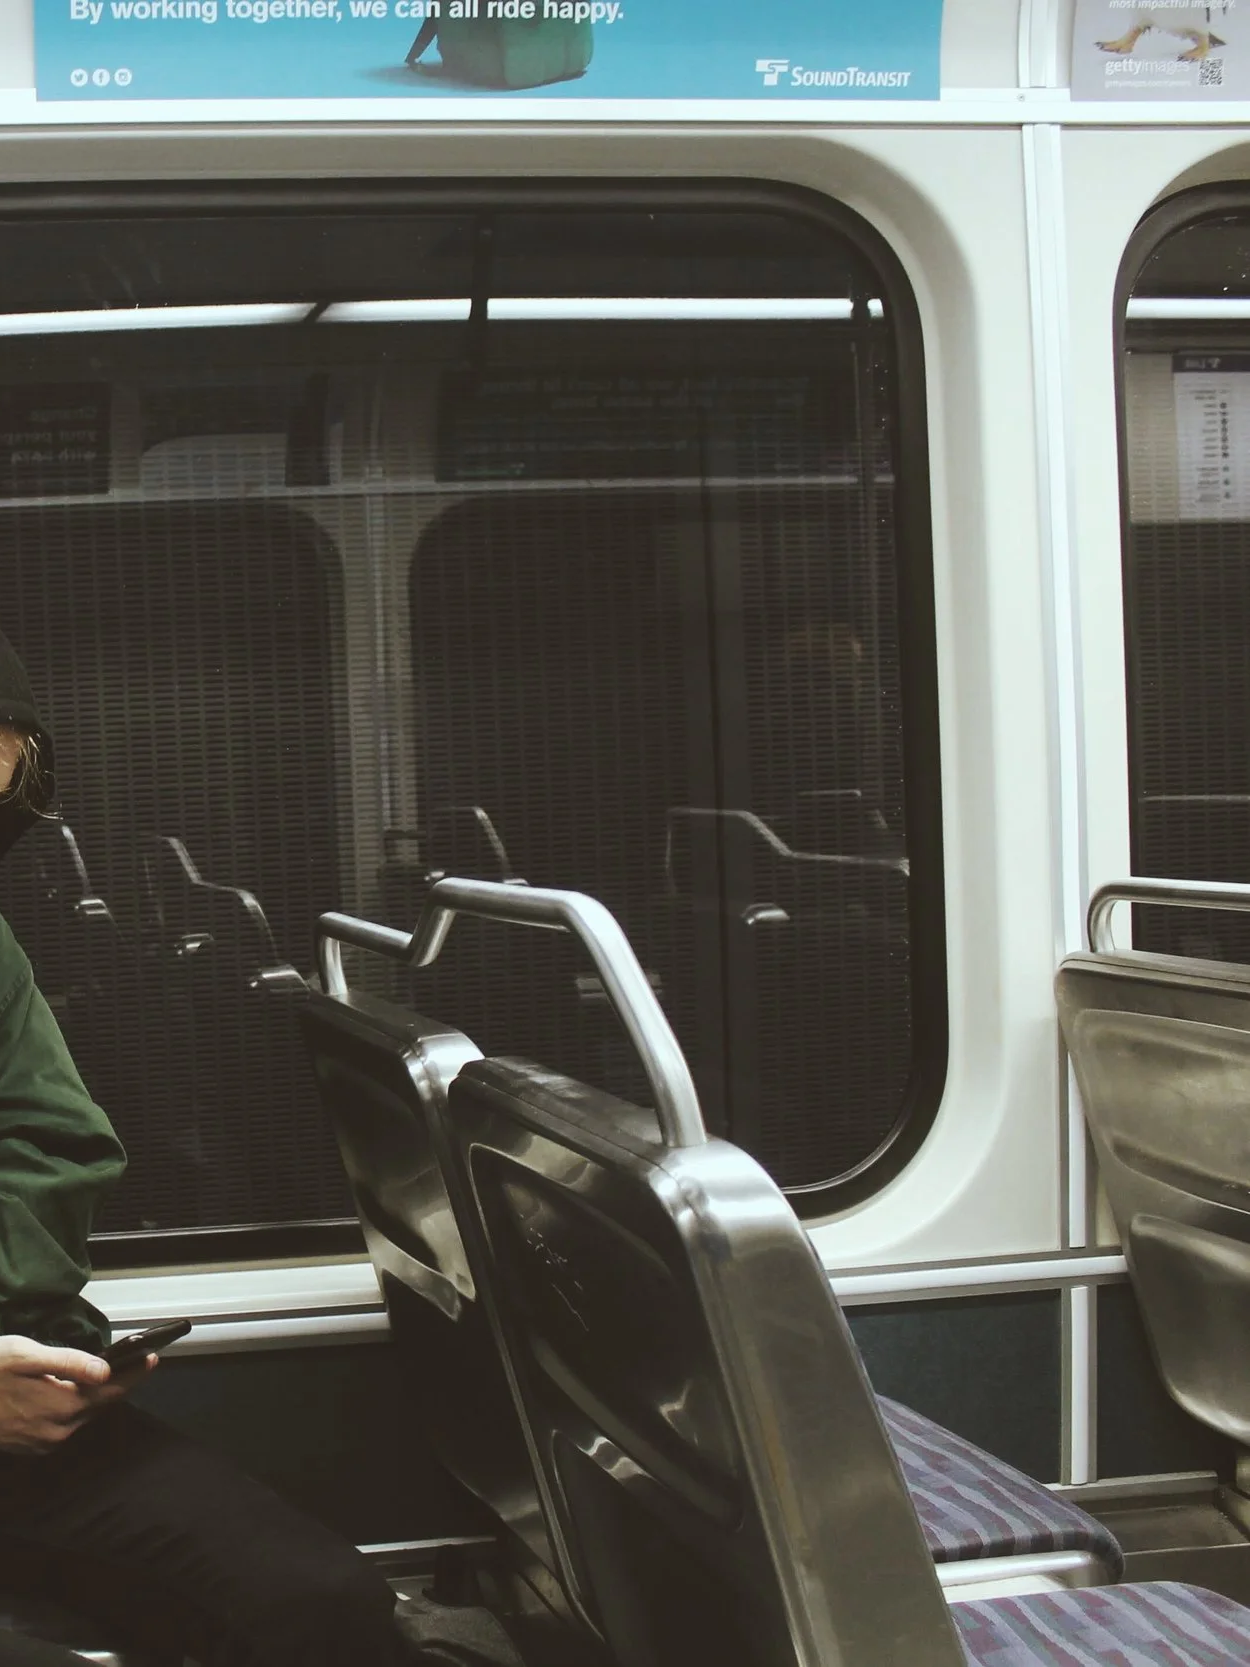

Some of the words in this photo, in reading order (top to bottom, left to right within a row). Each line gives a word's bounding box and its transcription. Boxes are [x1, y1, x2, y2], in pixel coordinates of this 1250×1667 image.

[70, 0, 102, 24] By
[110, 0, 217, 23] working
[226, 0, 342, 23] together,
[350, 1, 388, 18] we
[394, 1, 440, 18] can
[449, 0, 478, 18] all
[486, 0, 535, 18] ride
[543, 0, 624, 24] happy.
[1105, 59, 1190, 75] gettyimages
